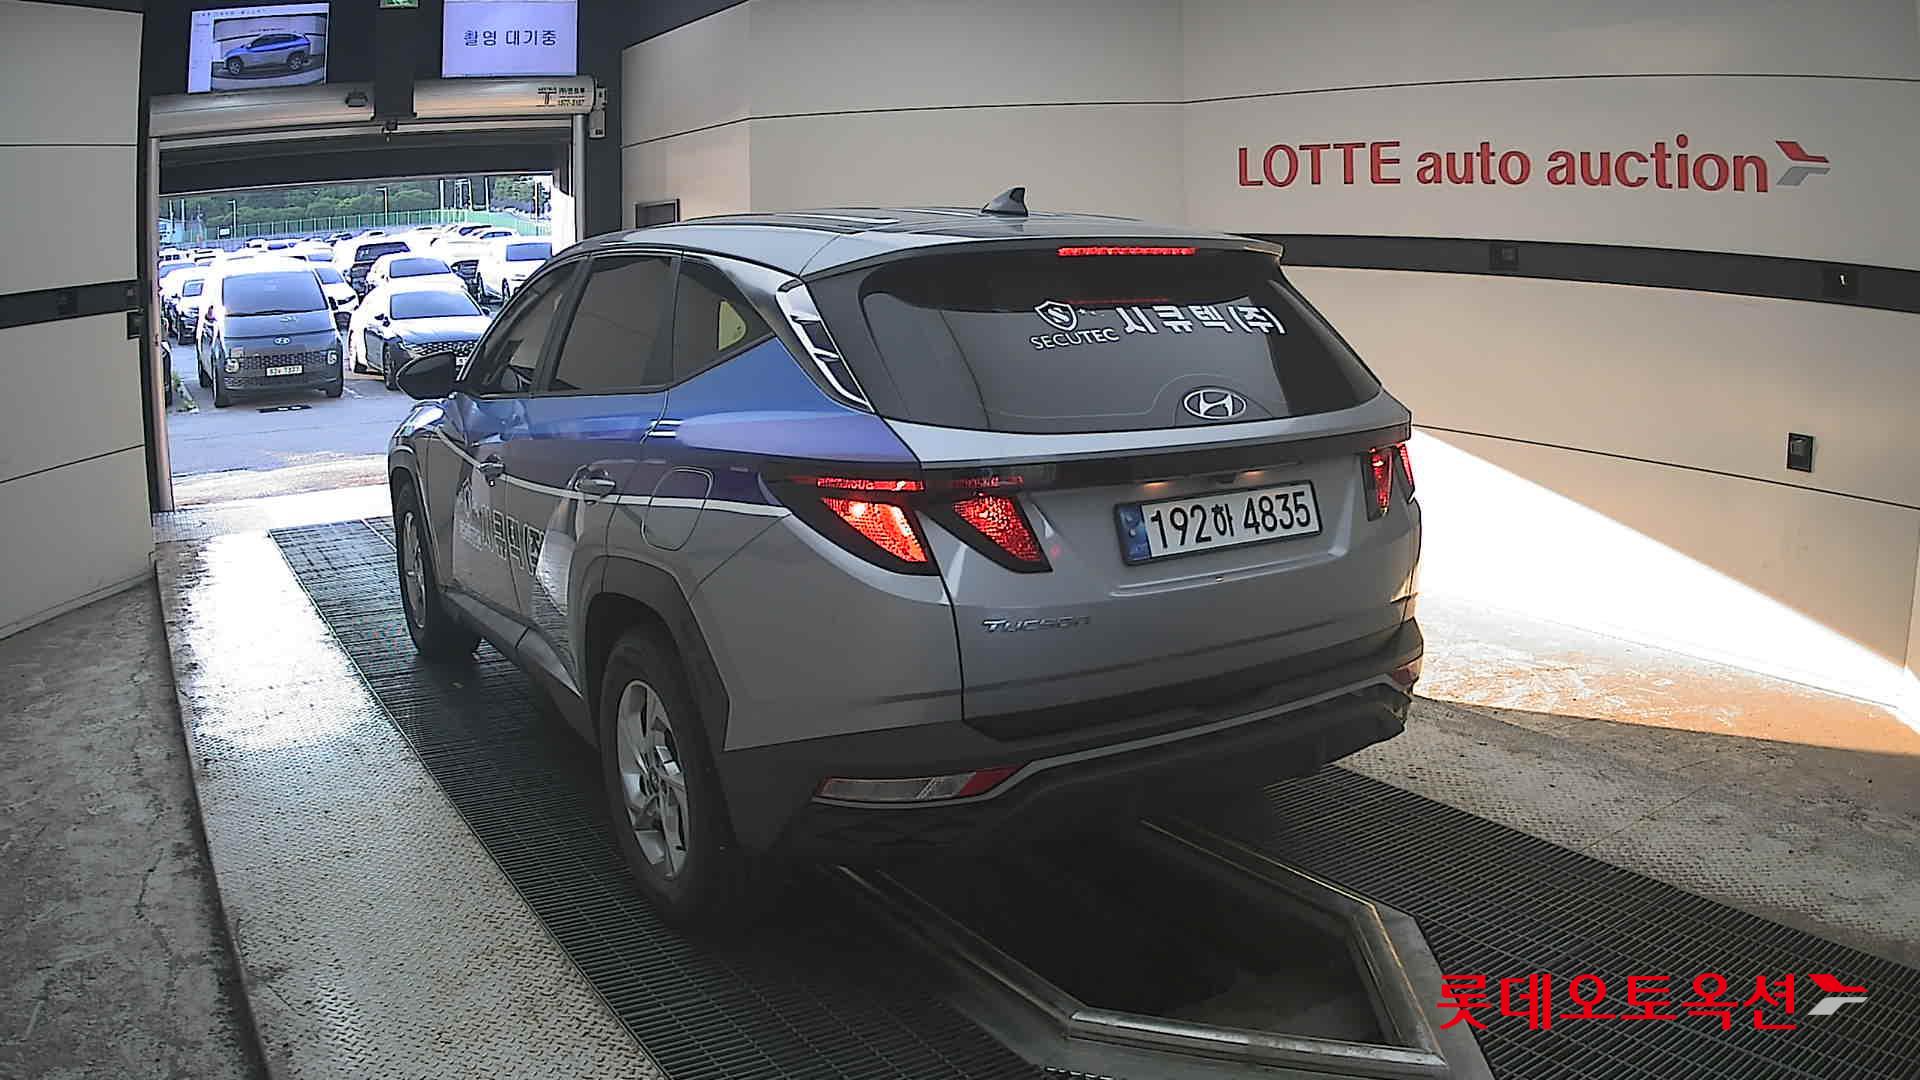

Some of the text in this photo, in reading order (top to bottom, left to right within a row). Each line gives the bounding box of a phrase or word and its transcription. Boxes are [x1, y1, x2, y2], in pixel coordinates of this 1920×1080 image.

[505, 29, 557, 47] 대기중
[1238, 134, 1769, 193] LOTTE auto auction
[1115, 305, 1286, 335] 시큐텍(주)
[1030, 327, 1120, 351] SECUTEC
[1150, 491, 1312, 550] 192하 4835
